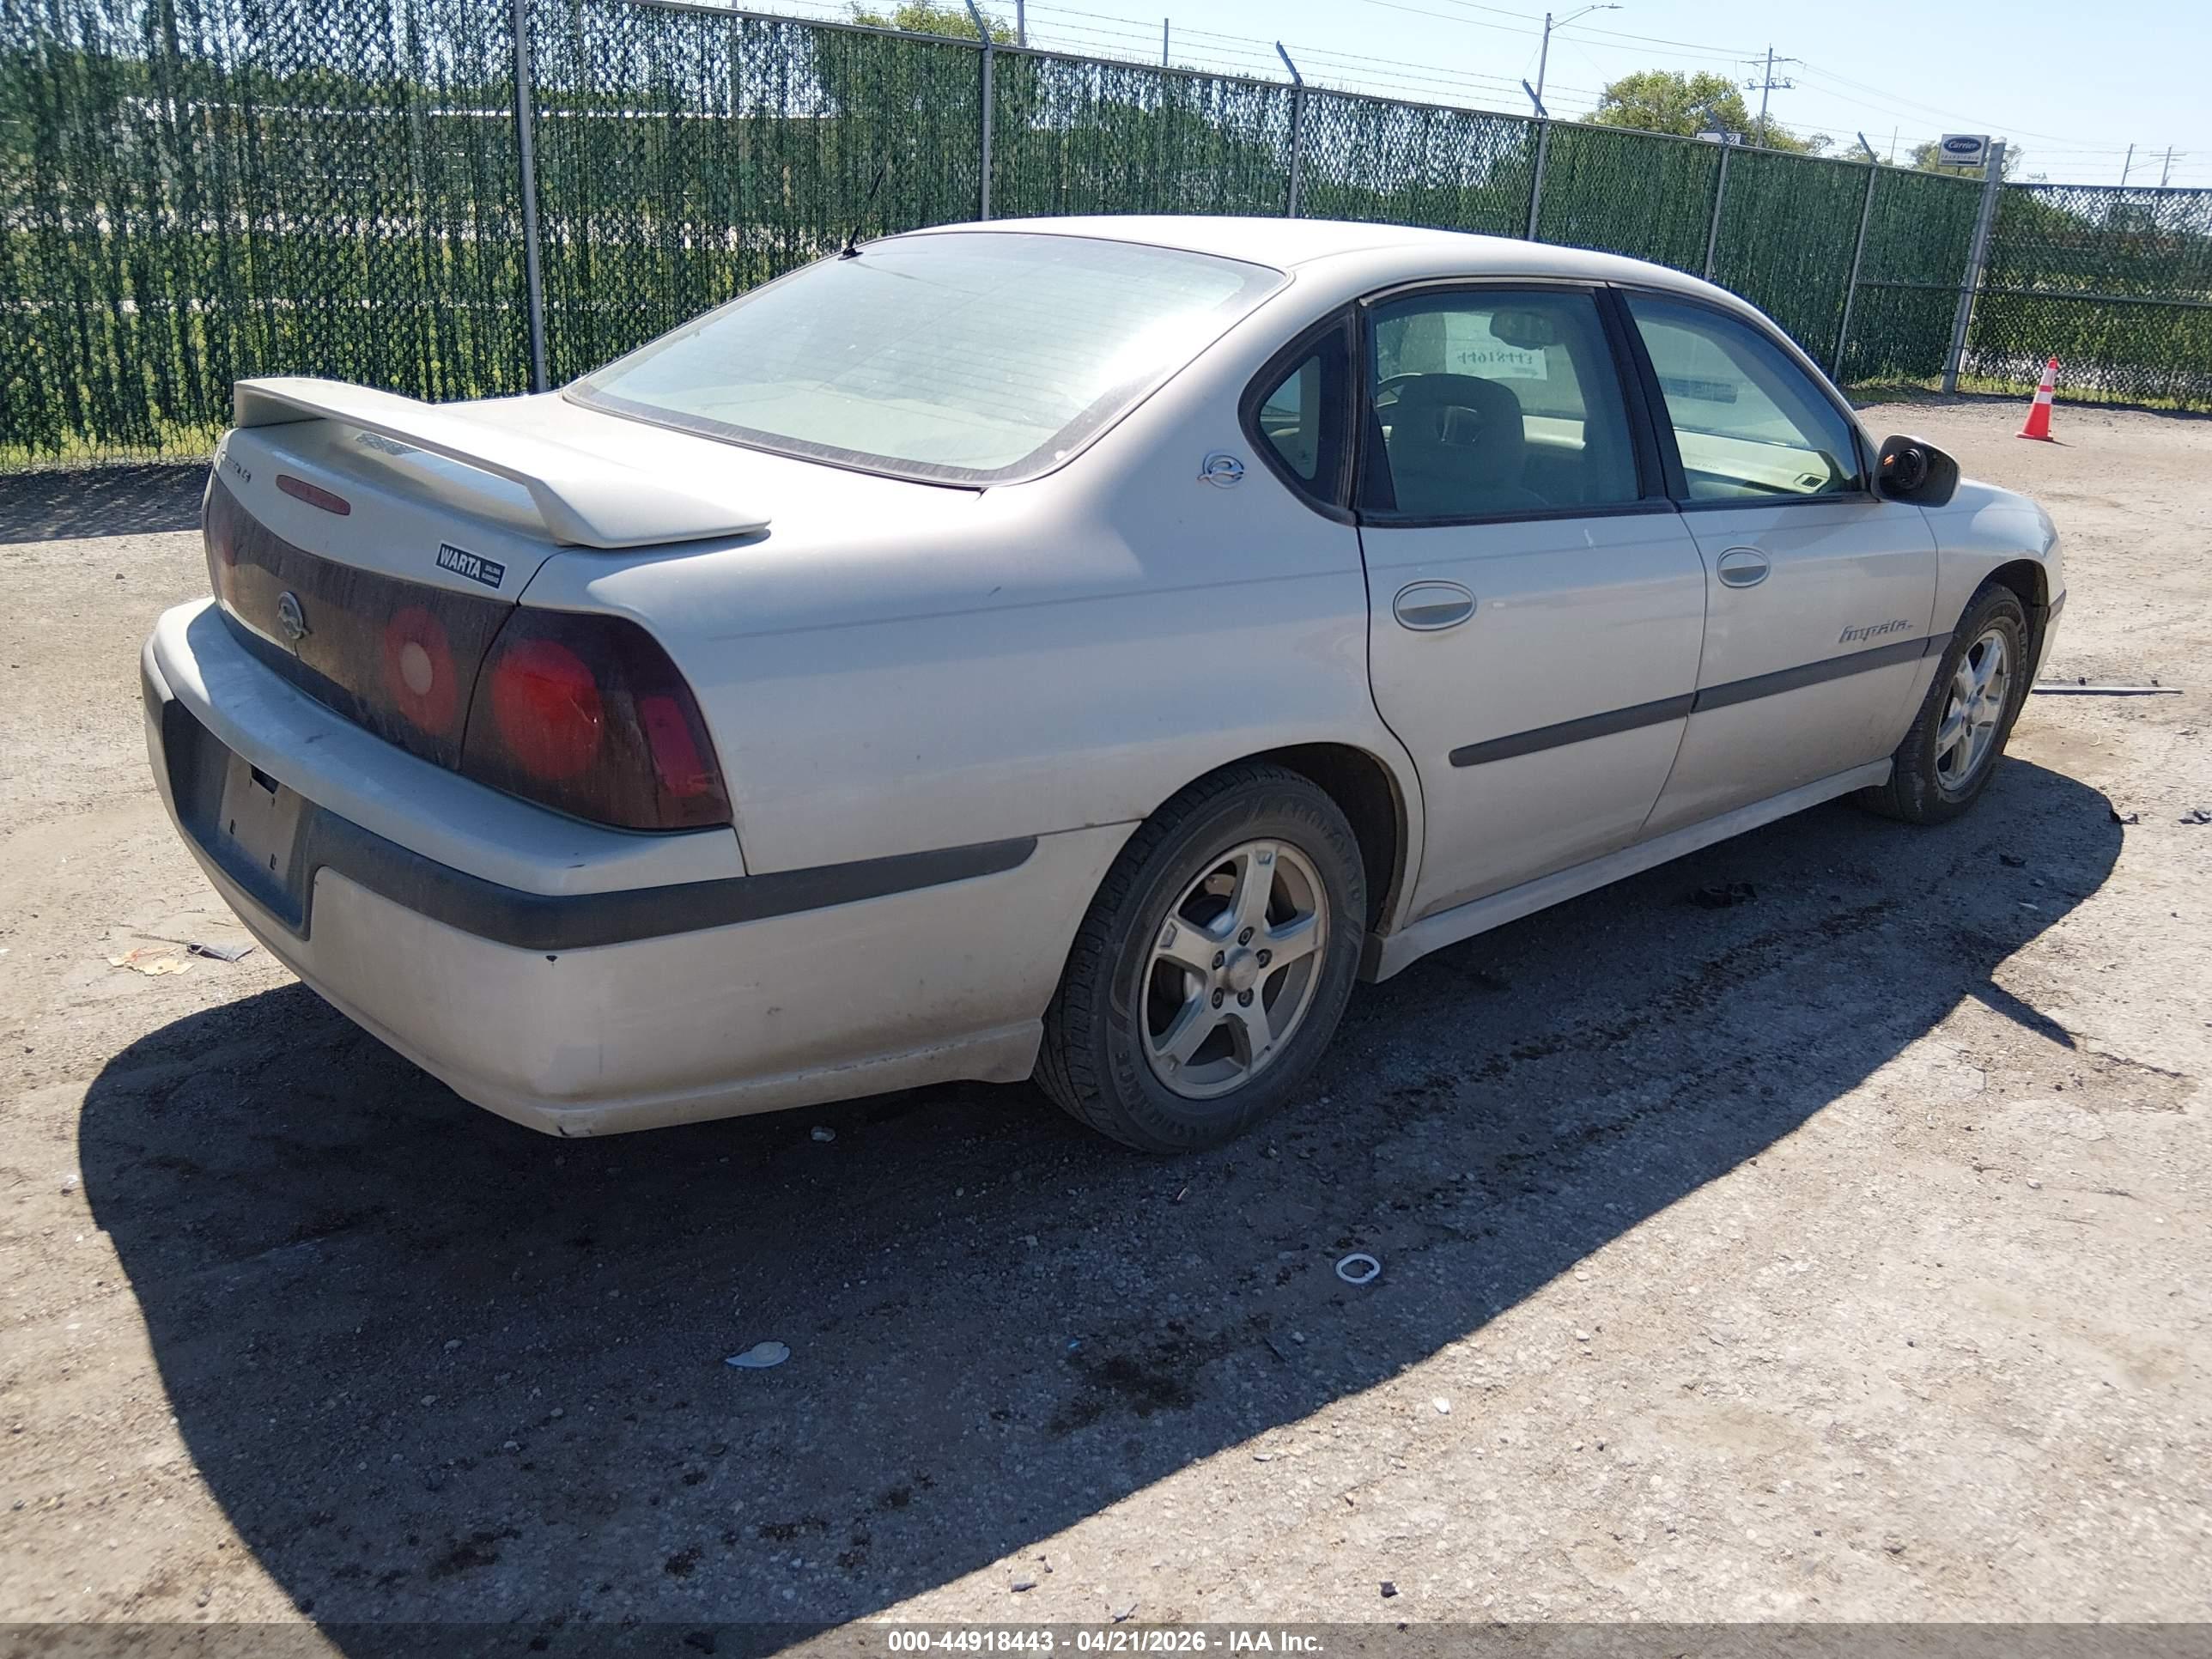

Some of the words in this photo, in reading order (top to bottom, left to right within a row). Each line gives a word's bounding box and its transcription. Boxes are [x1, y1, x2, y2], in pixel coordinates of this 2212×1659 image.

[1948, 141, 1978, 149] Carrier
[440, 546, 482, 579] WARTA
[1838, 618, 1913, 643] Impala
